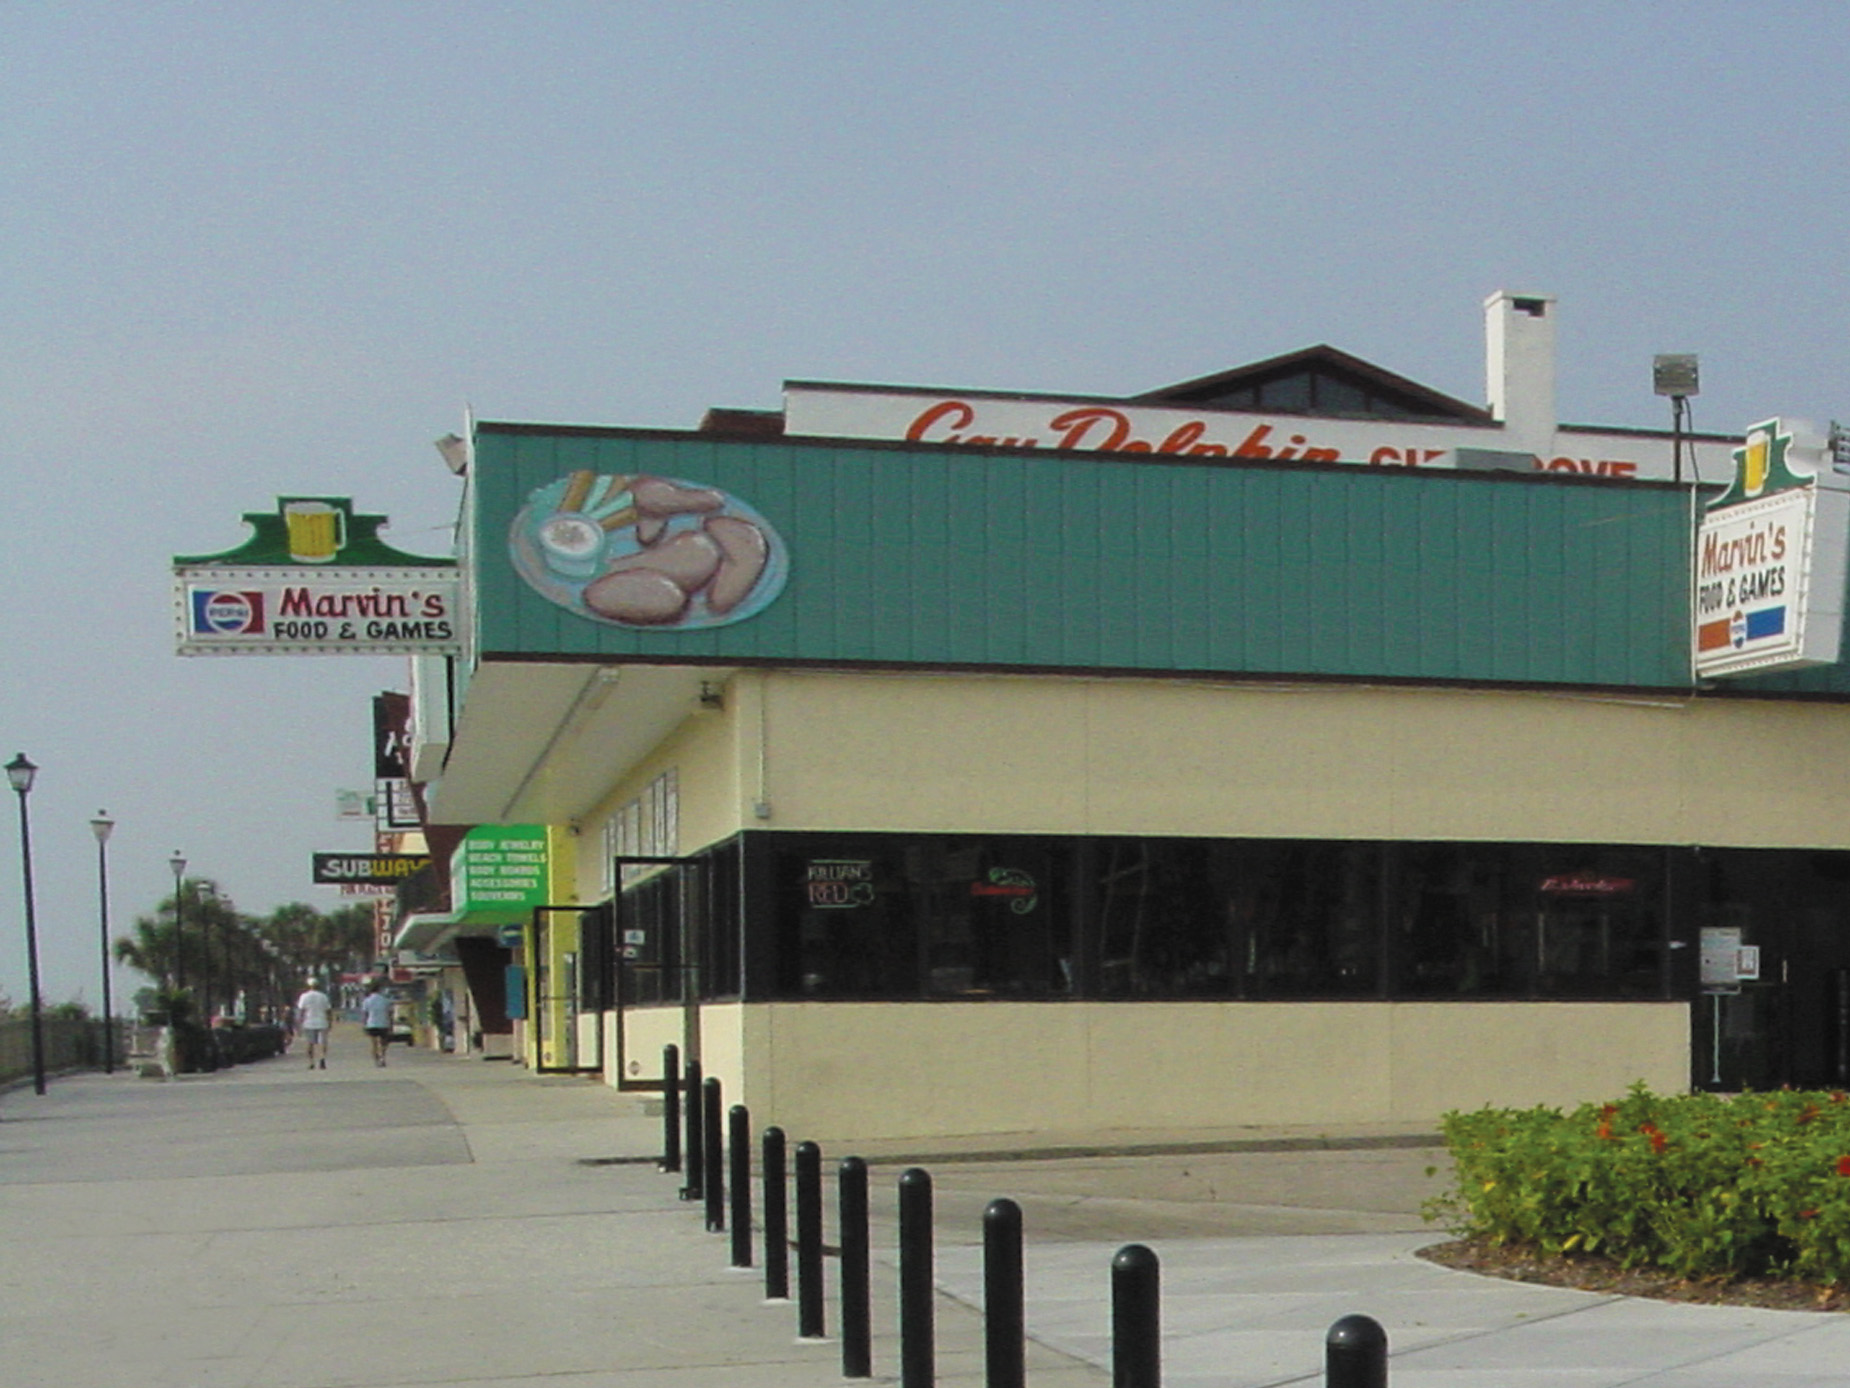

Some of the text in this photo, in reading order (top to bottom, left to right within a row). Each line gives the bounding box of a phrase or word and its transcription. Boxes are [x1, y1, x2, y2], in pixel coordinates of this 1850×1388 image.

[1702, 521, 1786, 579] Marvin's
[279, 587, 445, 618] Marvin's
[1700, 565, 1786, 614] FOOD & GAMES
[274, 621, 453, 640] FOOD & GAMES
